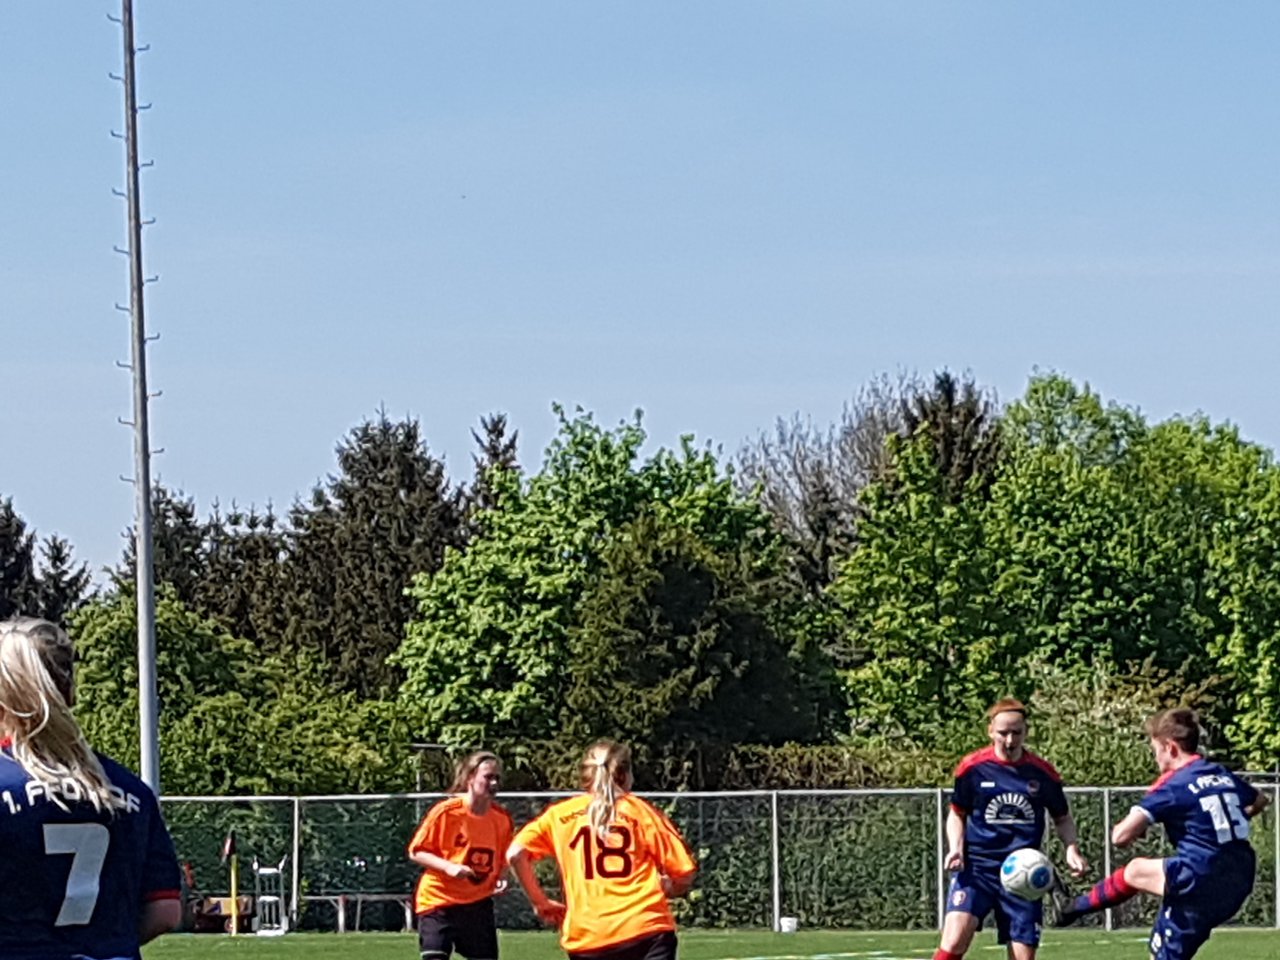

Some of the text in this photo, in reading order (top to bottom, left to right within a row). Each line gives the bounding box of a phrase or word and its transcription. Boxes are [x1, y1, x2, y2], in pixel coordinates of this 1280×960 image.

[1199, 791, 1249, 844] 15
[42, 823, 110, 927] 7
[569, 825, 632, 879] 18
